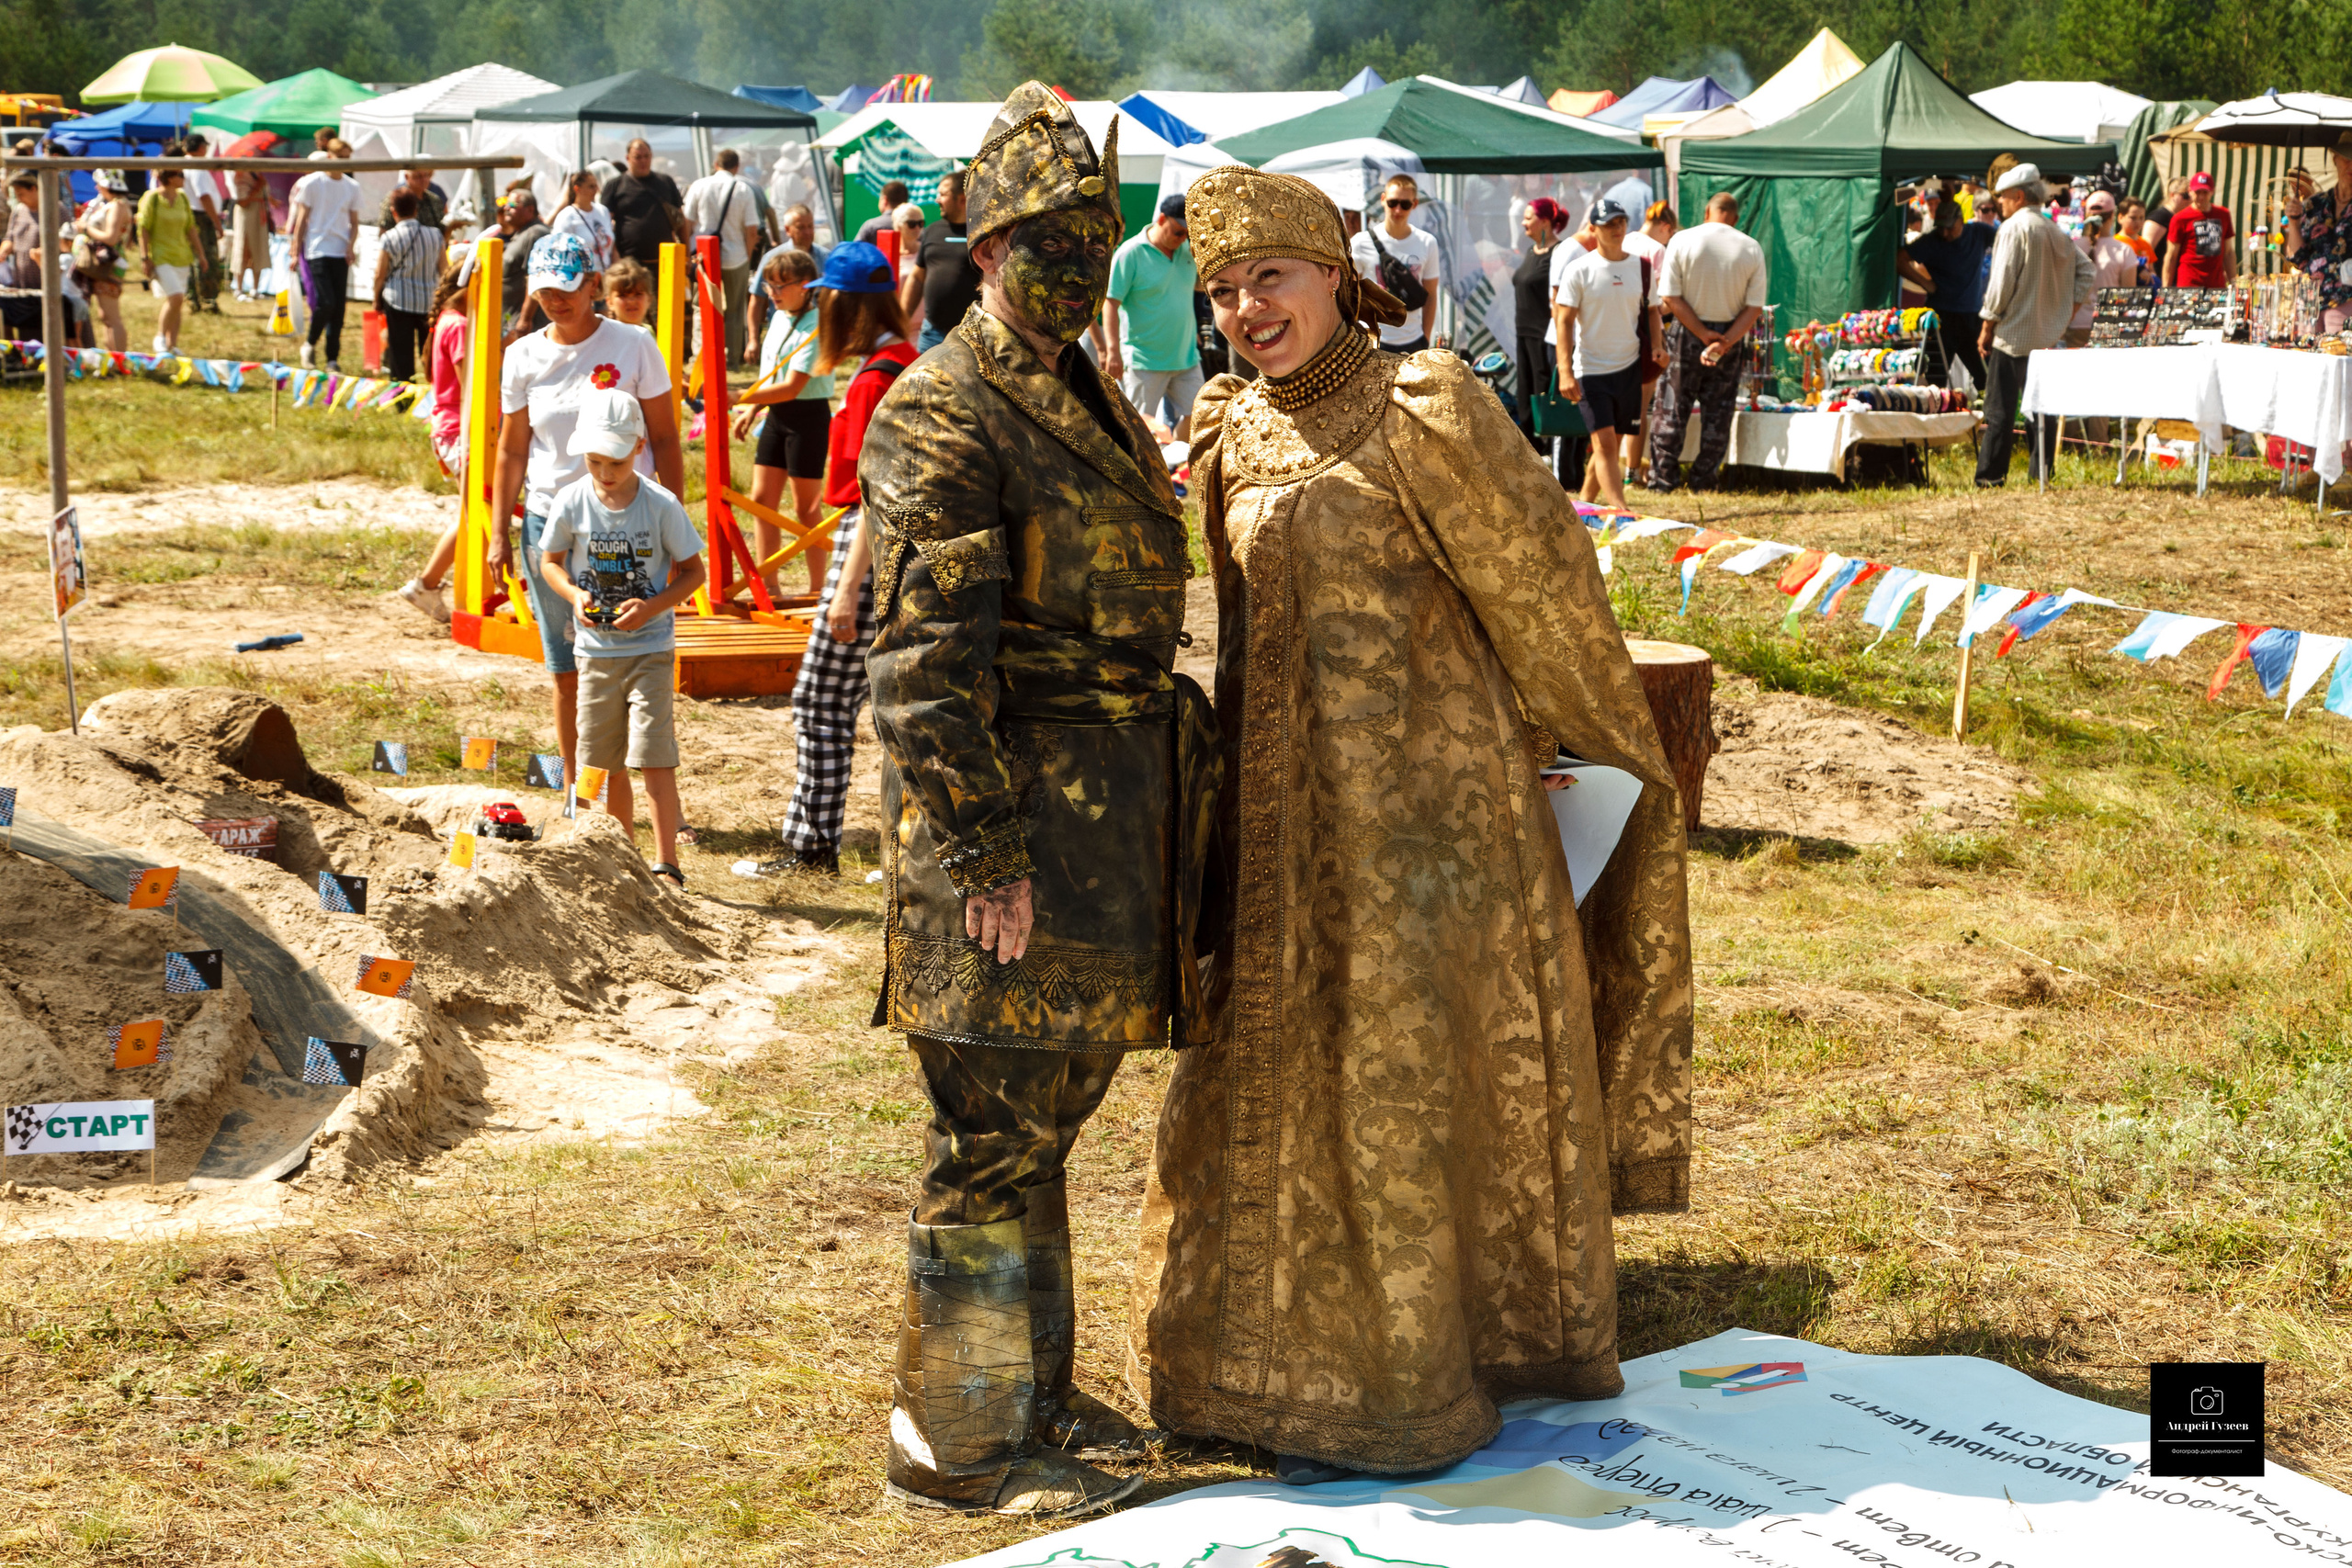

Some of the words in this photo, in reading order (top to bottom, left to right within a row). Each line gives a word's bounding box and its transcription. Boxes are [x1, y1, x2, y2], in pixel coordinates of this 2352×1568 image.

[590, 541, 628, 554] ROUGH
[598, 552, 616, 560] and
[589, 557, 632, 571] RUMBLE
[211, 828, 261, 845] ГАРАЖ
[46, 1114, 149, 1139] СТАРТ
[1828, 1393, 1931, 1435] ЦЕНТР
[1599, 1418, 1708, 1452] назад
[1981, 1421, 2132, 1466] ОБЛАСТИ
[1705, 1453, 1798, 1486] шага
[1784, 1485, 1827, 1496] 2
[1680, 1488, 1773, 1519] шага
[1760, 1515, 1803, 1533] 2
[1855, 1507, 1982, 1563] ответ
